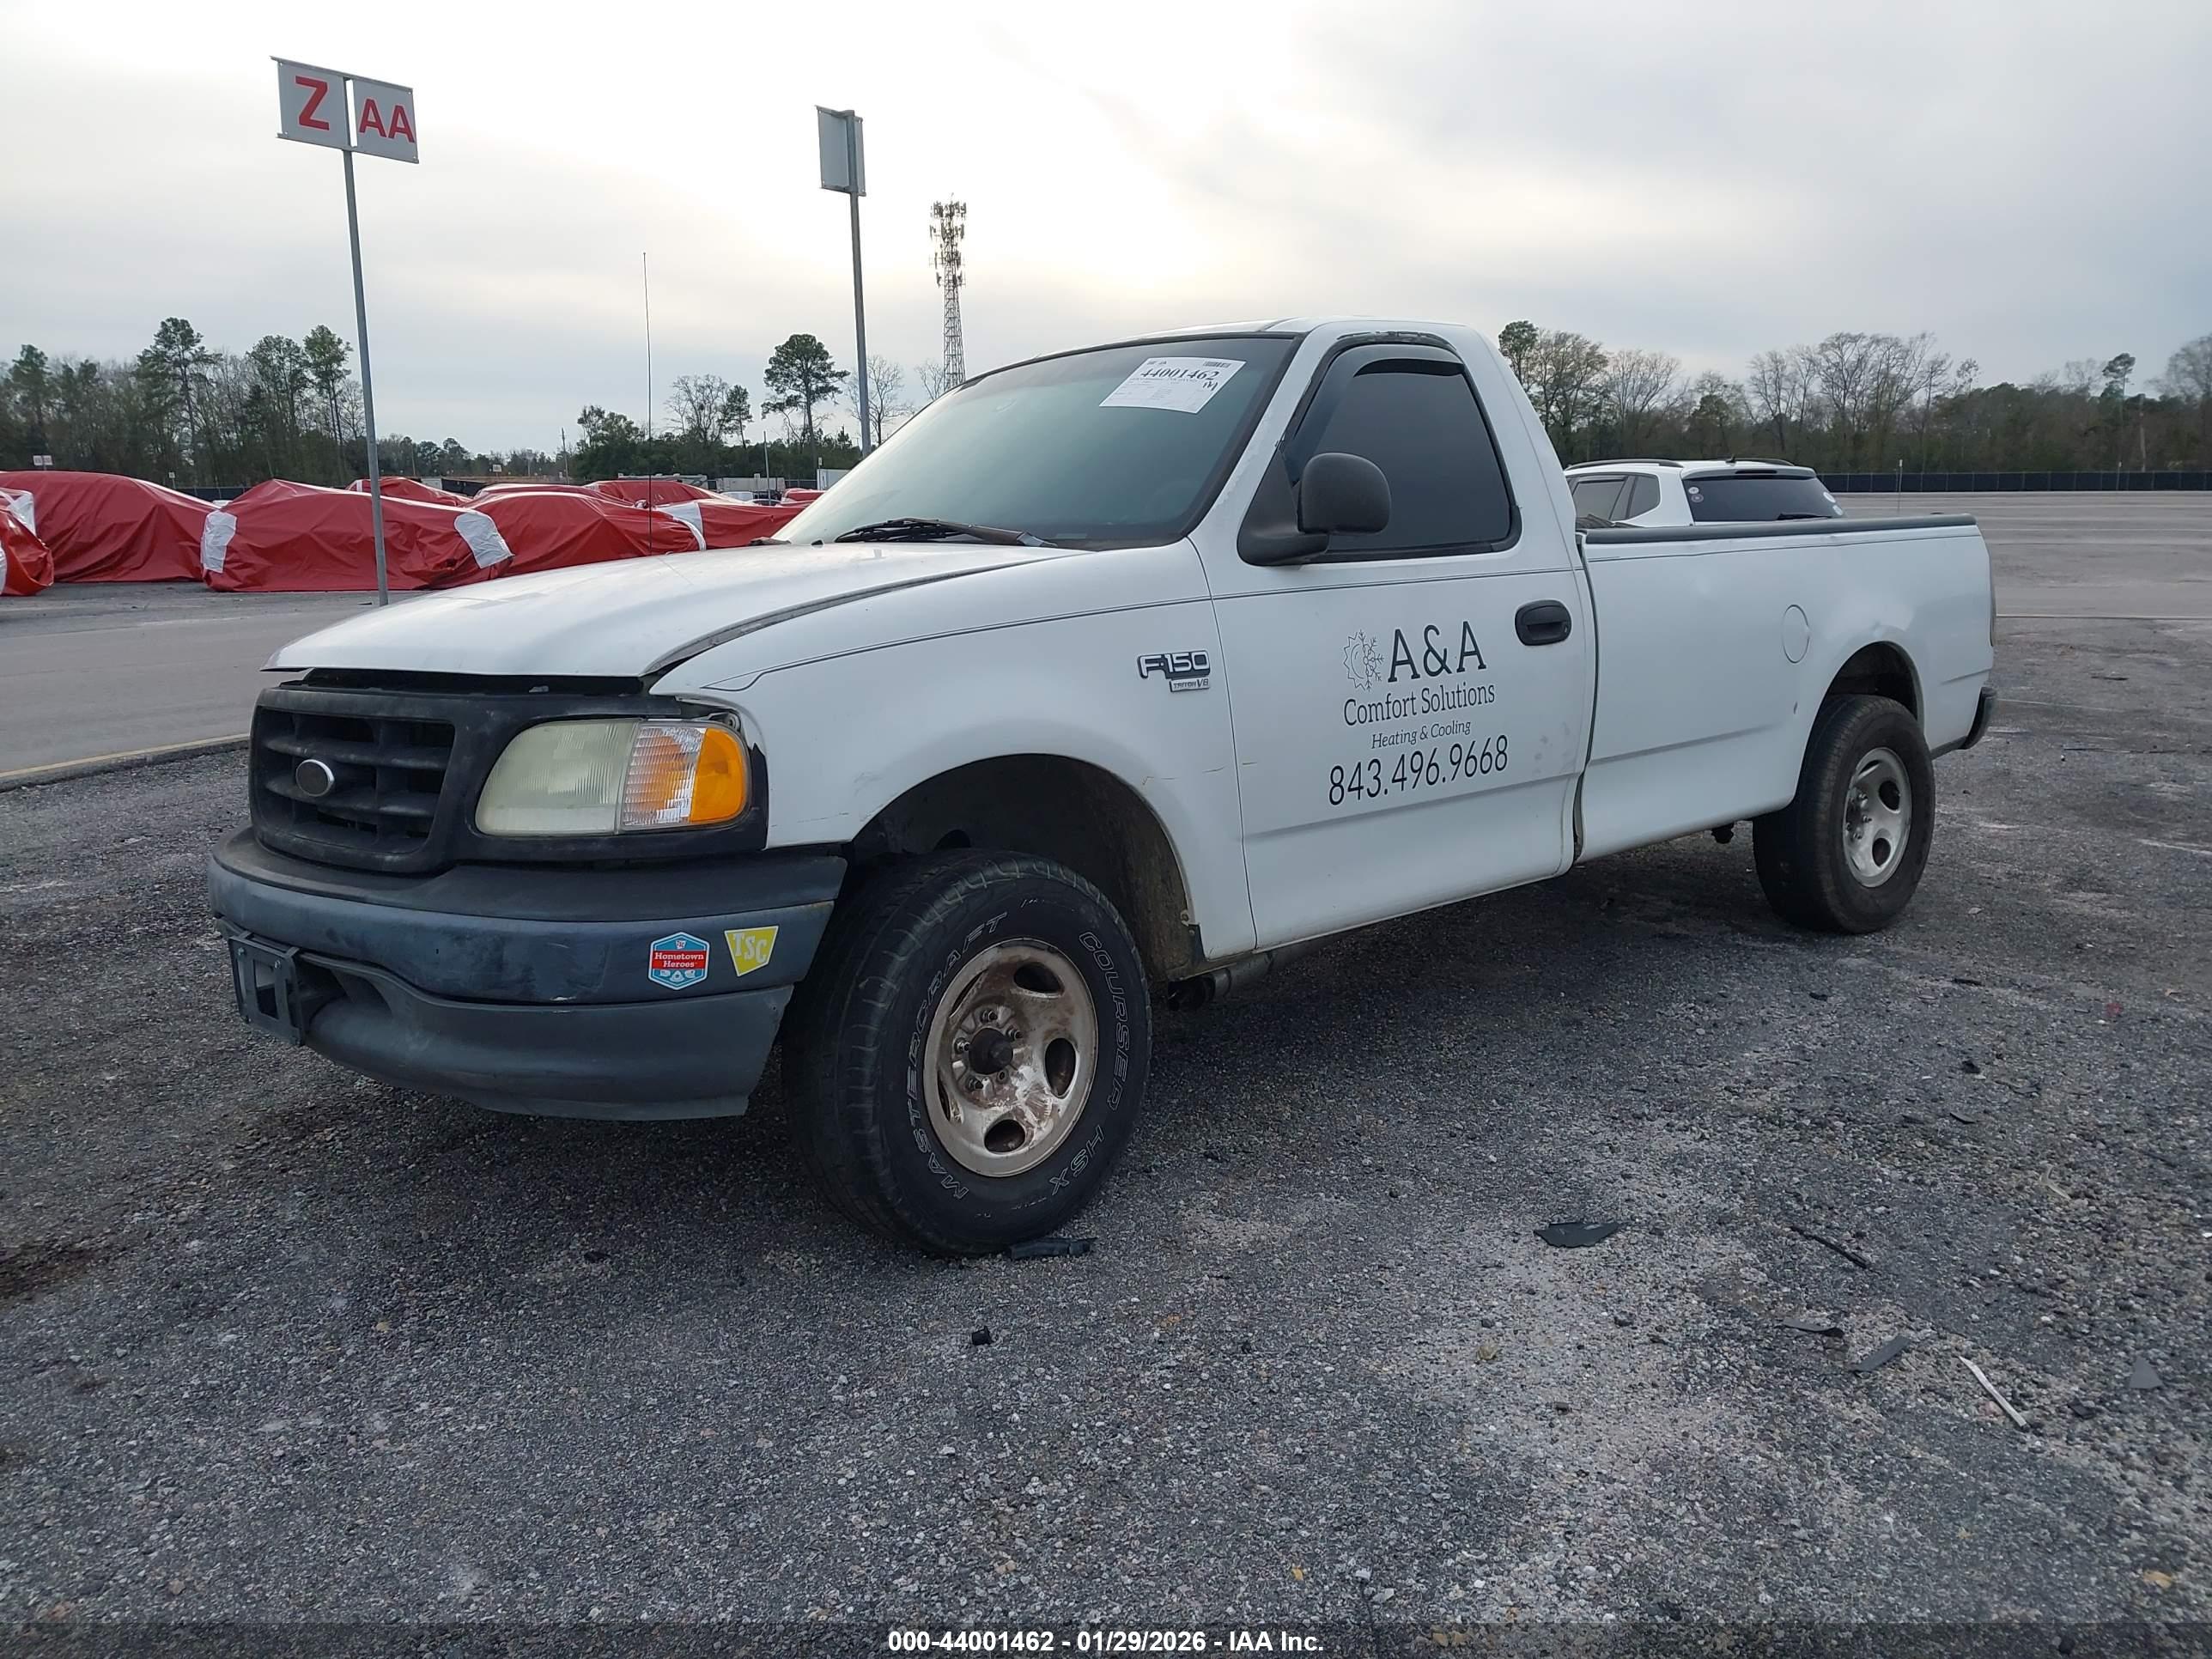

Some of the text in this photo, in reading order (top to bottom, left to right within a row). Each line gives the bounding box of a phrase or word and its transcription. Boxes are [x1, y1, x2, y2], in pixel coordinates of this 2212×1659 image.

[295, 76, 330, 131] Z
[359, 99, 415, 143] AA
[1140, 368, 1220, 380] 44001462
[1388, 621, 1486, 683] A&A
[1197, 678, 1209, 688] V8
[1344, 682, 1495, 726] Comfort Solutions
[1371, 720, 1471, 750] Heating & Cooling
[1329, 735, 1508, 805] 843.496.9668
[654, 951, 704, 961] Hometown
[732, 933, 768, 963] TSC
[1079, 931, 1131, 1112] COURSER
[906, 911, 1008, 1200] MASTERCRAFT
[1048, 1125, 1106, 1197] HSX
